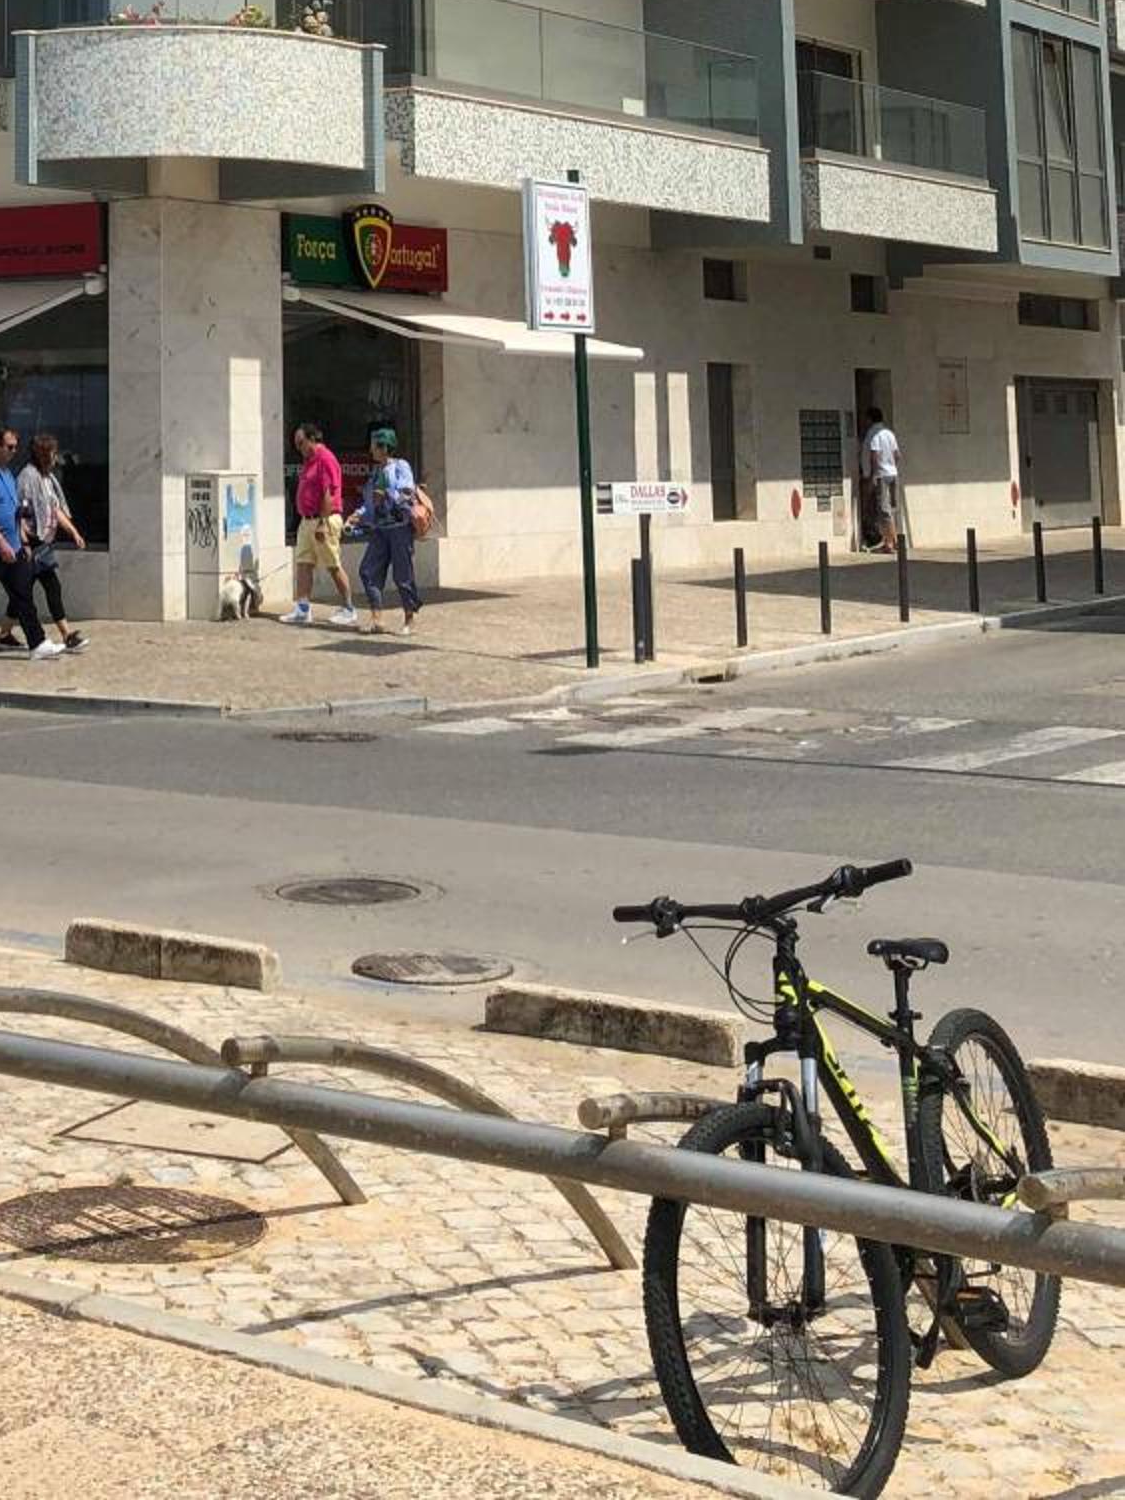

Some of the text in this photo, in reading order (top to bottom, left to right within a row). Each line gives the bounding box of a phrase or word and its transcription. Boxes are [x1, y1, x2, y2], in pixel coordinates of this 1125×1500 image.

[296, 233, 437, 271] Força ortugal
[630, 484, 666, 498] DALLAS
